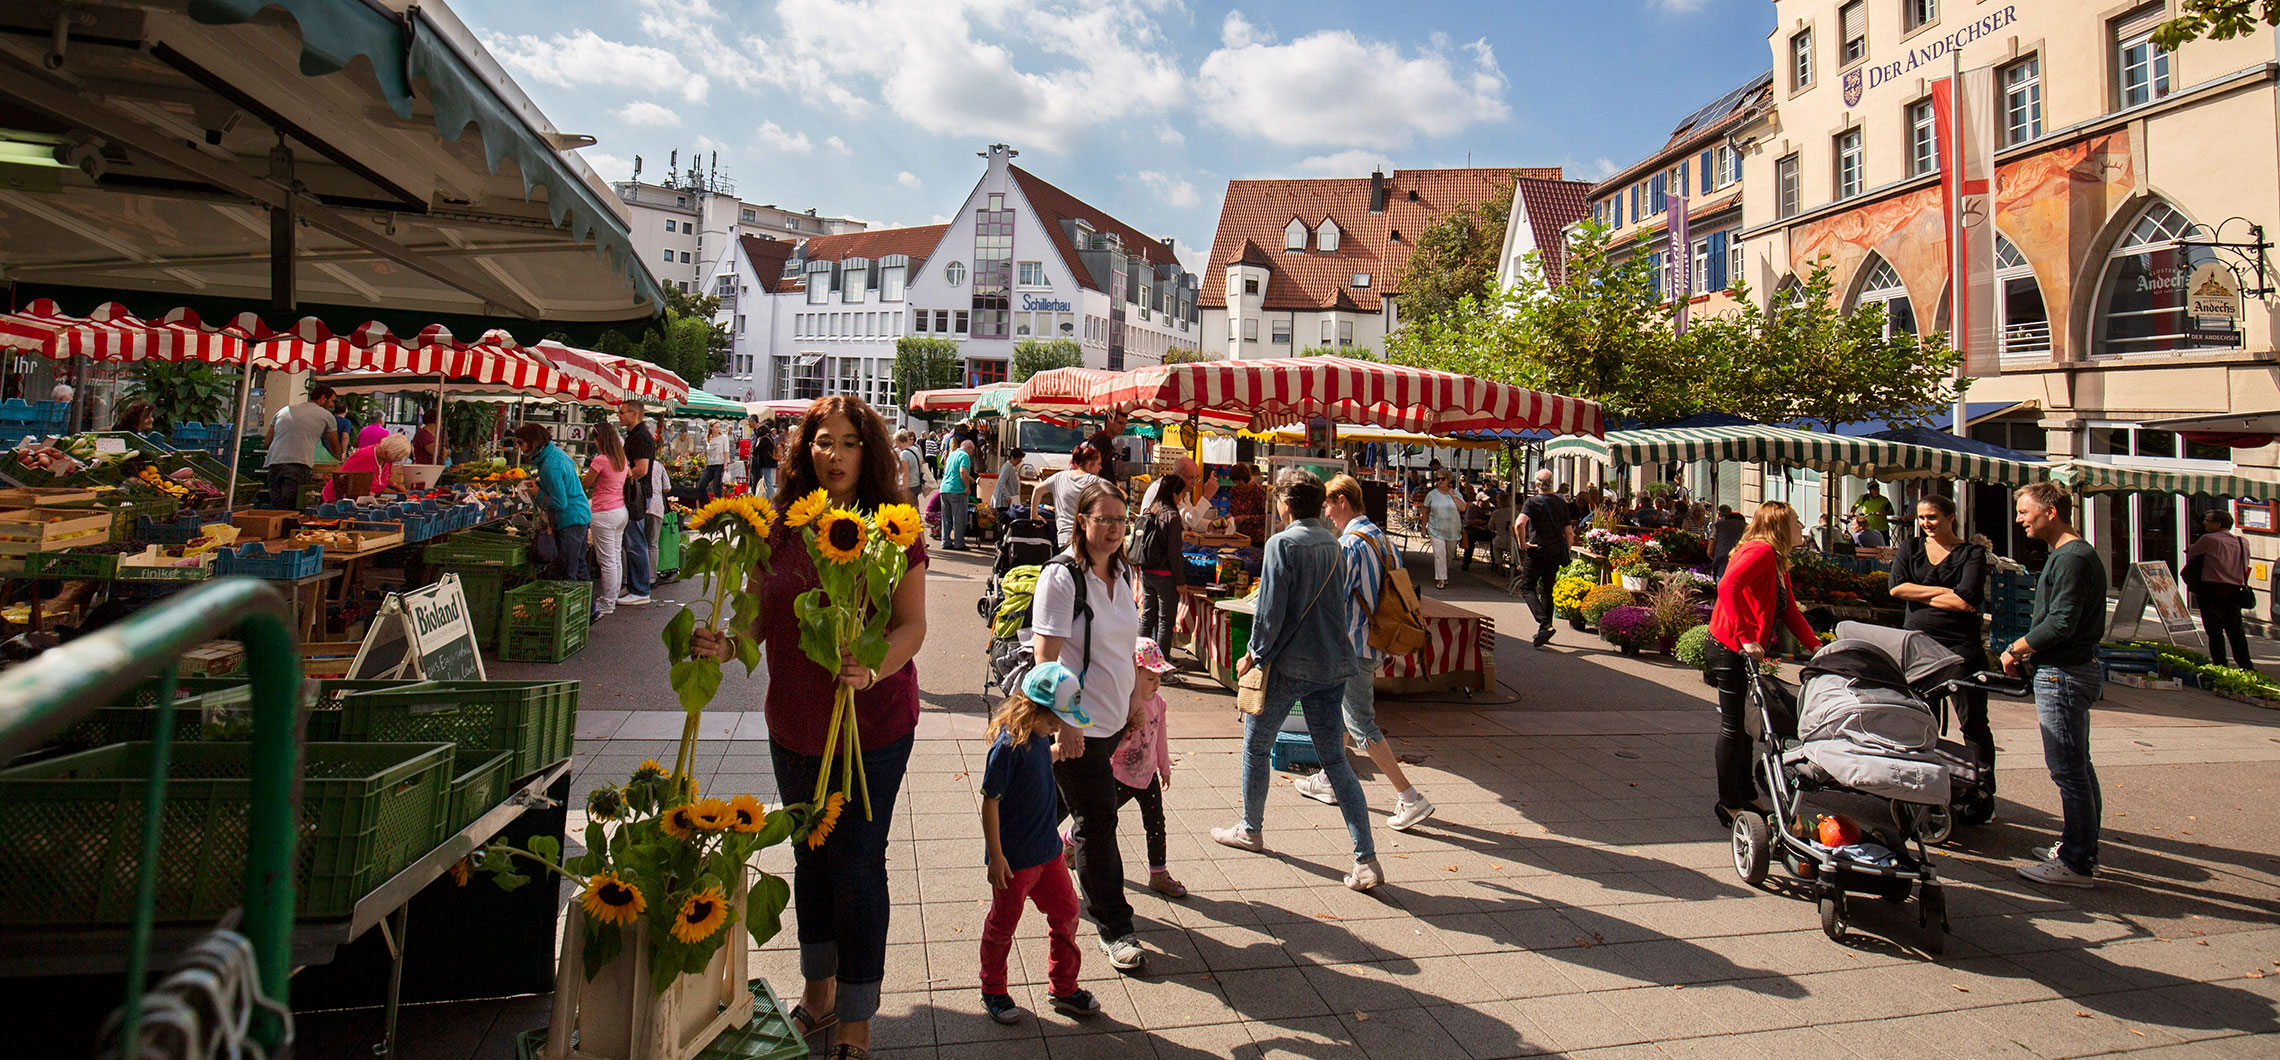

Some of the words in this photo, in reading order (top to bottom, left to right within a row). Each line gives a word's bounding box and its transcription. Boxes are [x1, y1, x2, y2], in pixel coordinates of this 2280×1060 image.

[1869, 61, 1903, 90] DER
[1905, 5, 2018, 74] ANDECHSER
[1022, 293, 1071, 312] Schillerbau
[2193, 301, 2236, 314] Andechs
[13, 355, 38, 374] Ihr
[415, 591, 460, 636] Bioland
